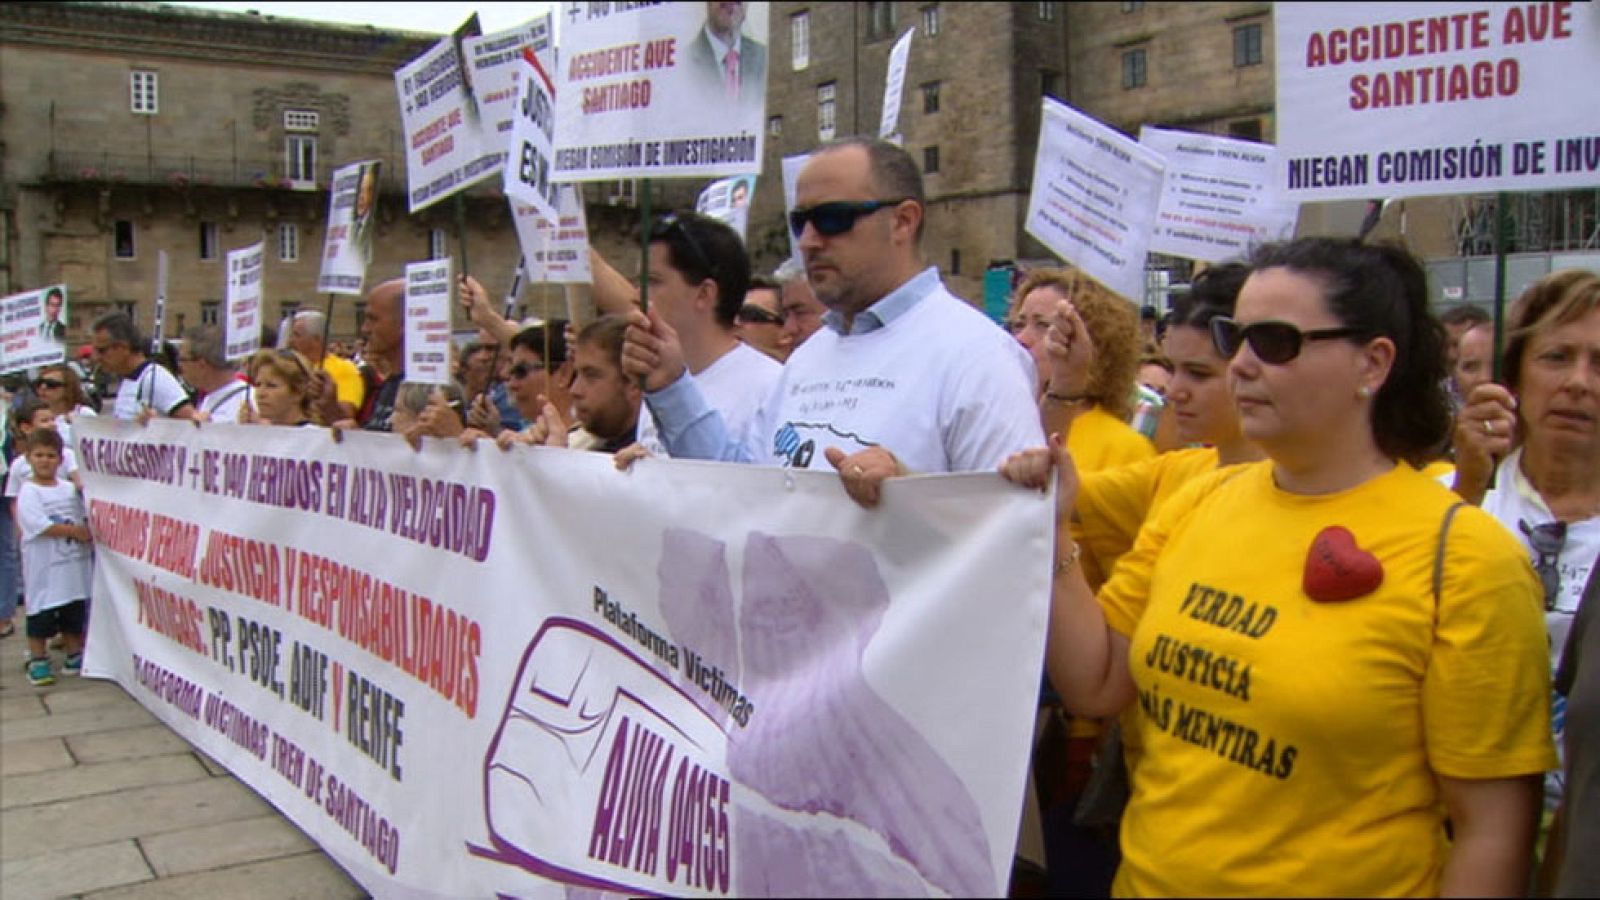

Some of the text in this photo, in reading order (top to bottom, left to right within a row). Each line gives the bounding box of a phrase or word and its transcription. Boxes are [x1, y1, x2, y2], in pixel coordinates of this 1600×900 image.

[569, 38, 676, 81] ACCIDENTE AVE
[1306, 2, 1572, 68] ACCIDENTE AVE
[582, 80, 652, 114] SANTIAGO
[1349, 58, 1520, 111] SANTIAGO
[644, 143, 660, 166] DE
[663, 130, 757, 166] INVESTIGACIÓN
[1287, 154, 1369, 189] NIEGAN
[1377, 139, 1502, 184] COMISIÓN
[1513, 142, 1546, 176] DE
[177, 445, 188, 488] Y
[203, 448, 220, 495] DE
[223, 452, 249, 499] 140
[248, 454, 324, 513] HERIDOS
[327, 463, 349, 519] EN
[349, 466, 388, 531] ALTA
[389, 472, 497, 564] VELOCIDAD
[147, 513, 200, 585] VERDAD,
[201, 529, 282, 608] JUSTICIA
[284, 545, 297, 613] Y
[298, 550, 482, 720] RESPONSABILIDADES
[593, 585, 680, 671] Plataforma
[1179, 582, 1279, 640] VERDAD
[208, 605, 235, 674] PP,
[237, 616, 285, 700] PSOE,
[290, 639, 329, 722] ADIF
[331, 660, 344, 734] Y
[347, 670, 405, 783] RENFE
[1145, 634, 1252, 702] JUSTICIA
[132, 653, 400, 876] PLATAFORMA VÍCTIMAS TREN DE SANTIAGO
[1171, 702, 1299, 780] MENTIRAS
[588, 715, 731, 895] ALVIA 04155
